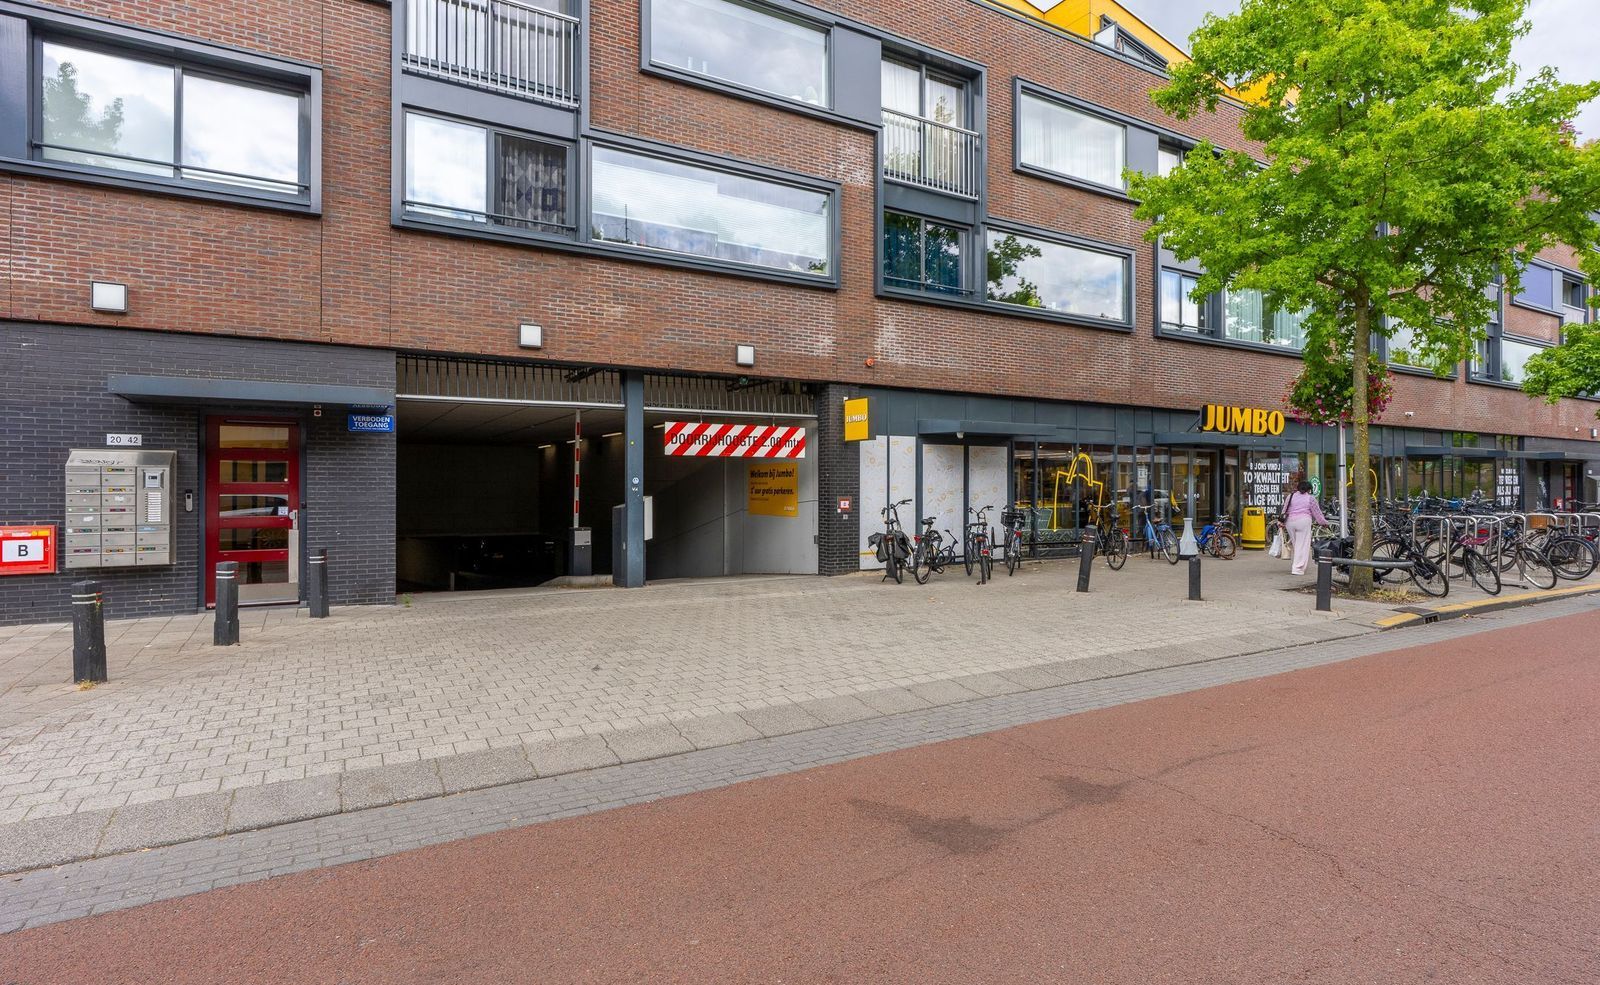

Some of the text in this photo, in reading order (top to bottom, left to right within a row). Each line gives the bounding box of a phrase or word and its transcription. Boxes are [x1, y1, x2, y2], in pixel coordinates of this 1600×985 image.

[846, 413, 867, 423] JUMBO
[1203, 404, 1285, 436] JUMBO
[110, 436, 138, 444] 20 42
[671, 433, 758, 447] DOORRIJHOOGTE
[785, 438, 800, 448] mtr
[1254, 484, 1280, 493] TEGEN EEN
[18, 544, 29, 557] B
